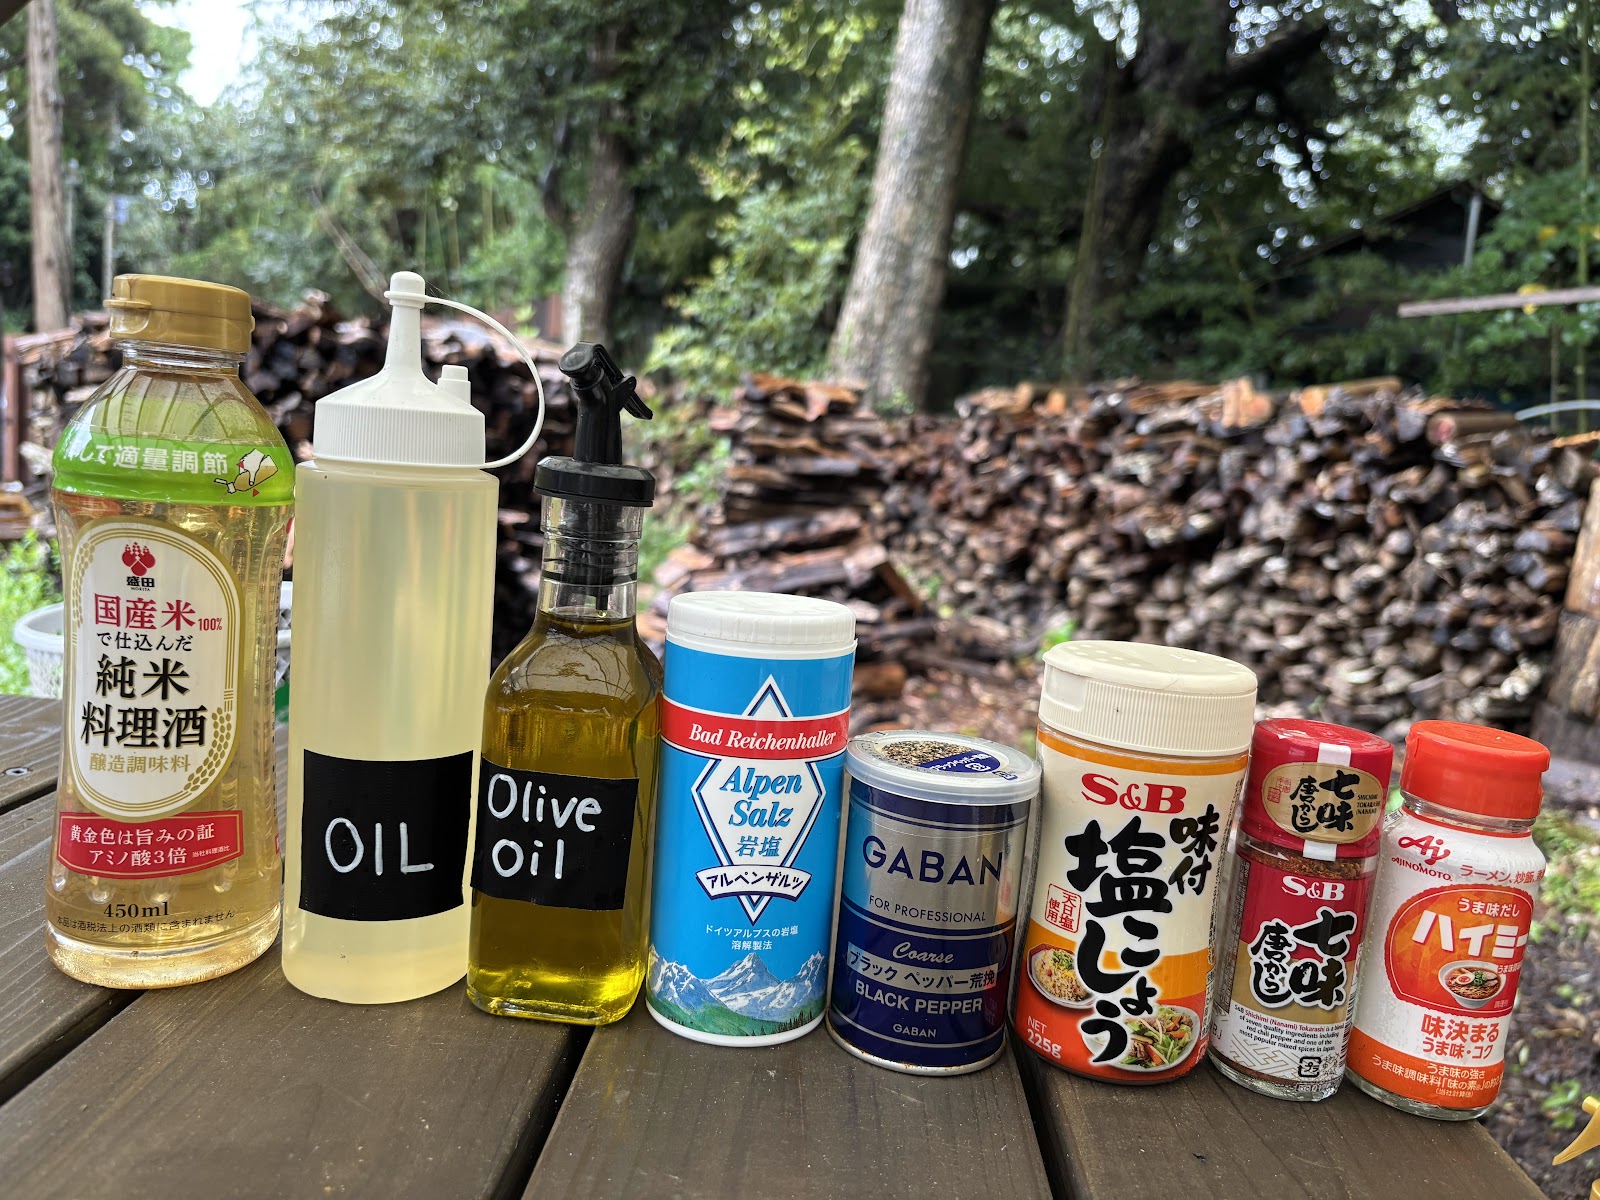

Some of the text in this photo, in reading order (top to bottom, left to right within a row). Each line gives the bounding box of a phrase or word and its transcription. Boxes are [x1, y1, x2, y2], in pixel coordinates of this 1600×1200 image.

[126, 576, 155, 588] 盛田
[94, 593, 223, 632] 国産米 100%
[96, 631, 194, 652] で仕込んだ
[96, 653, 191, 701] 純米
[80, 701, 208, 749] 料理酒
[689, 723, 837, 751] Bad Reichenhaller
[89, 752, 191, 774] 醸造調味料
[719, 765, 803, 801] Alpen
[1081, 772, 1187, 814] S&B
[487, 772, 602, 833] Olive
[728, 799, 794, 828] Salz
[1316, 769, 1361, 832] 七味
[70, 822, 215, 847] 黄金色は旨みの証
[325, 816, 435, 876] OIL
[735, 835, 783, 858] 岩塩
[862, 835, 1003, 886] GABAN
[1168, 803, 1221, 896] 味付
[705, 870, 804, 891] アルペンザルツ
[1281, 875, 1346, 901] S&B
[56, 909, 236, 933] 本品は酒税法上の酒類に含まれません
[103, 901, 170, 919] 450ml
[869, 894, 986, 923] FOR PROFESSIONAL
[1046, 897, 1060, 925] 使用
[1058, 891, 1078, 931] 天日塩
[1458, 897, 1521, 918] うま味だし
[705, 924, 799, 940] ドイツアルプスの岩塩
[731, 939, 773, 951] 溶解製法
[1064, 815, 1174, 1063] 塩こしょう
[1411, 909, 1529, 959] ハイミー
[892, 941, 955, 964] Coarse
[1288, 909, 1355, 1007] 七味
[849, 950, 996, 990] ブラック ペッパー荒挽
[855, 978, 983, 1015] BLACK PEPPER
[892, 1023, 937, 1038] GABAN
[1026, 1015, 1047, 1034] NET
[1234, 1004, 1245, 1014] S&B
[1244, 1009, 1269, 1024] Shichimi
[1269, 1018, 1298, 1031] (Nanami)
[1299, 1024, 1326, 1032] Tokarashi
[1245, 1017, 1262, 1028] seven
[1263, 1024, 1284, 1035] quality
[1285, 1029, 1318, 1039] ingredients
[1319, 1031, 1340, 1039] including
[1420, 1013, 1500, 1044] 味決まる
[1026, 1028, 1062, 1060] 225g
[1239, 1028, 1253, 1039] most
[1253, 1036, 1277, 1047] popular
[1277, 1042, 1297, 1050] mixed
[1298, 1045, 1316, 1053] spices
[1322, 1045, 1335, 1053] Japan
[1246, 1025, 1257, 1033] red
[1270, 1033, 1292, 1043] pepper
[1422, 1036, 1494, 1060] うま味・コク
[1426, 1062, 1486, 1080] うま味の強さ
